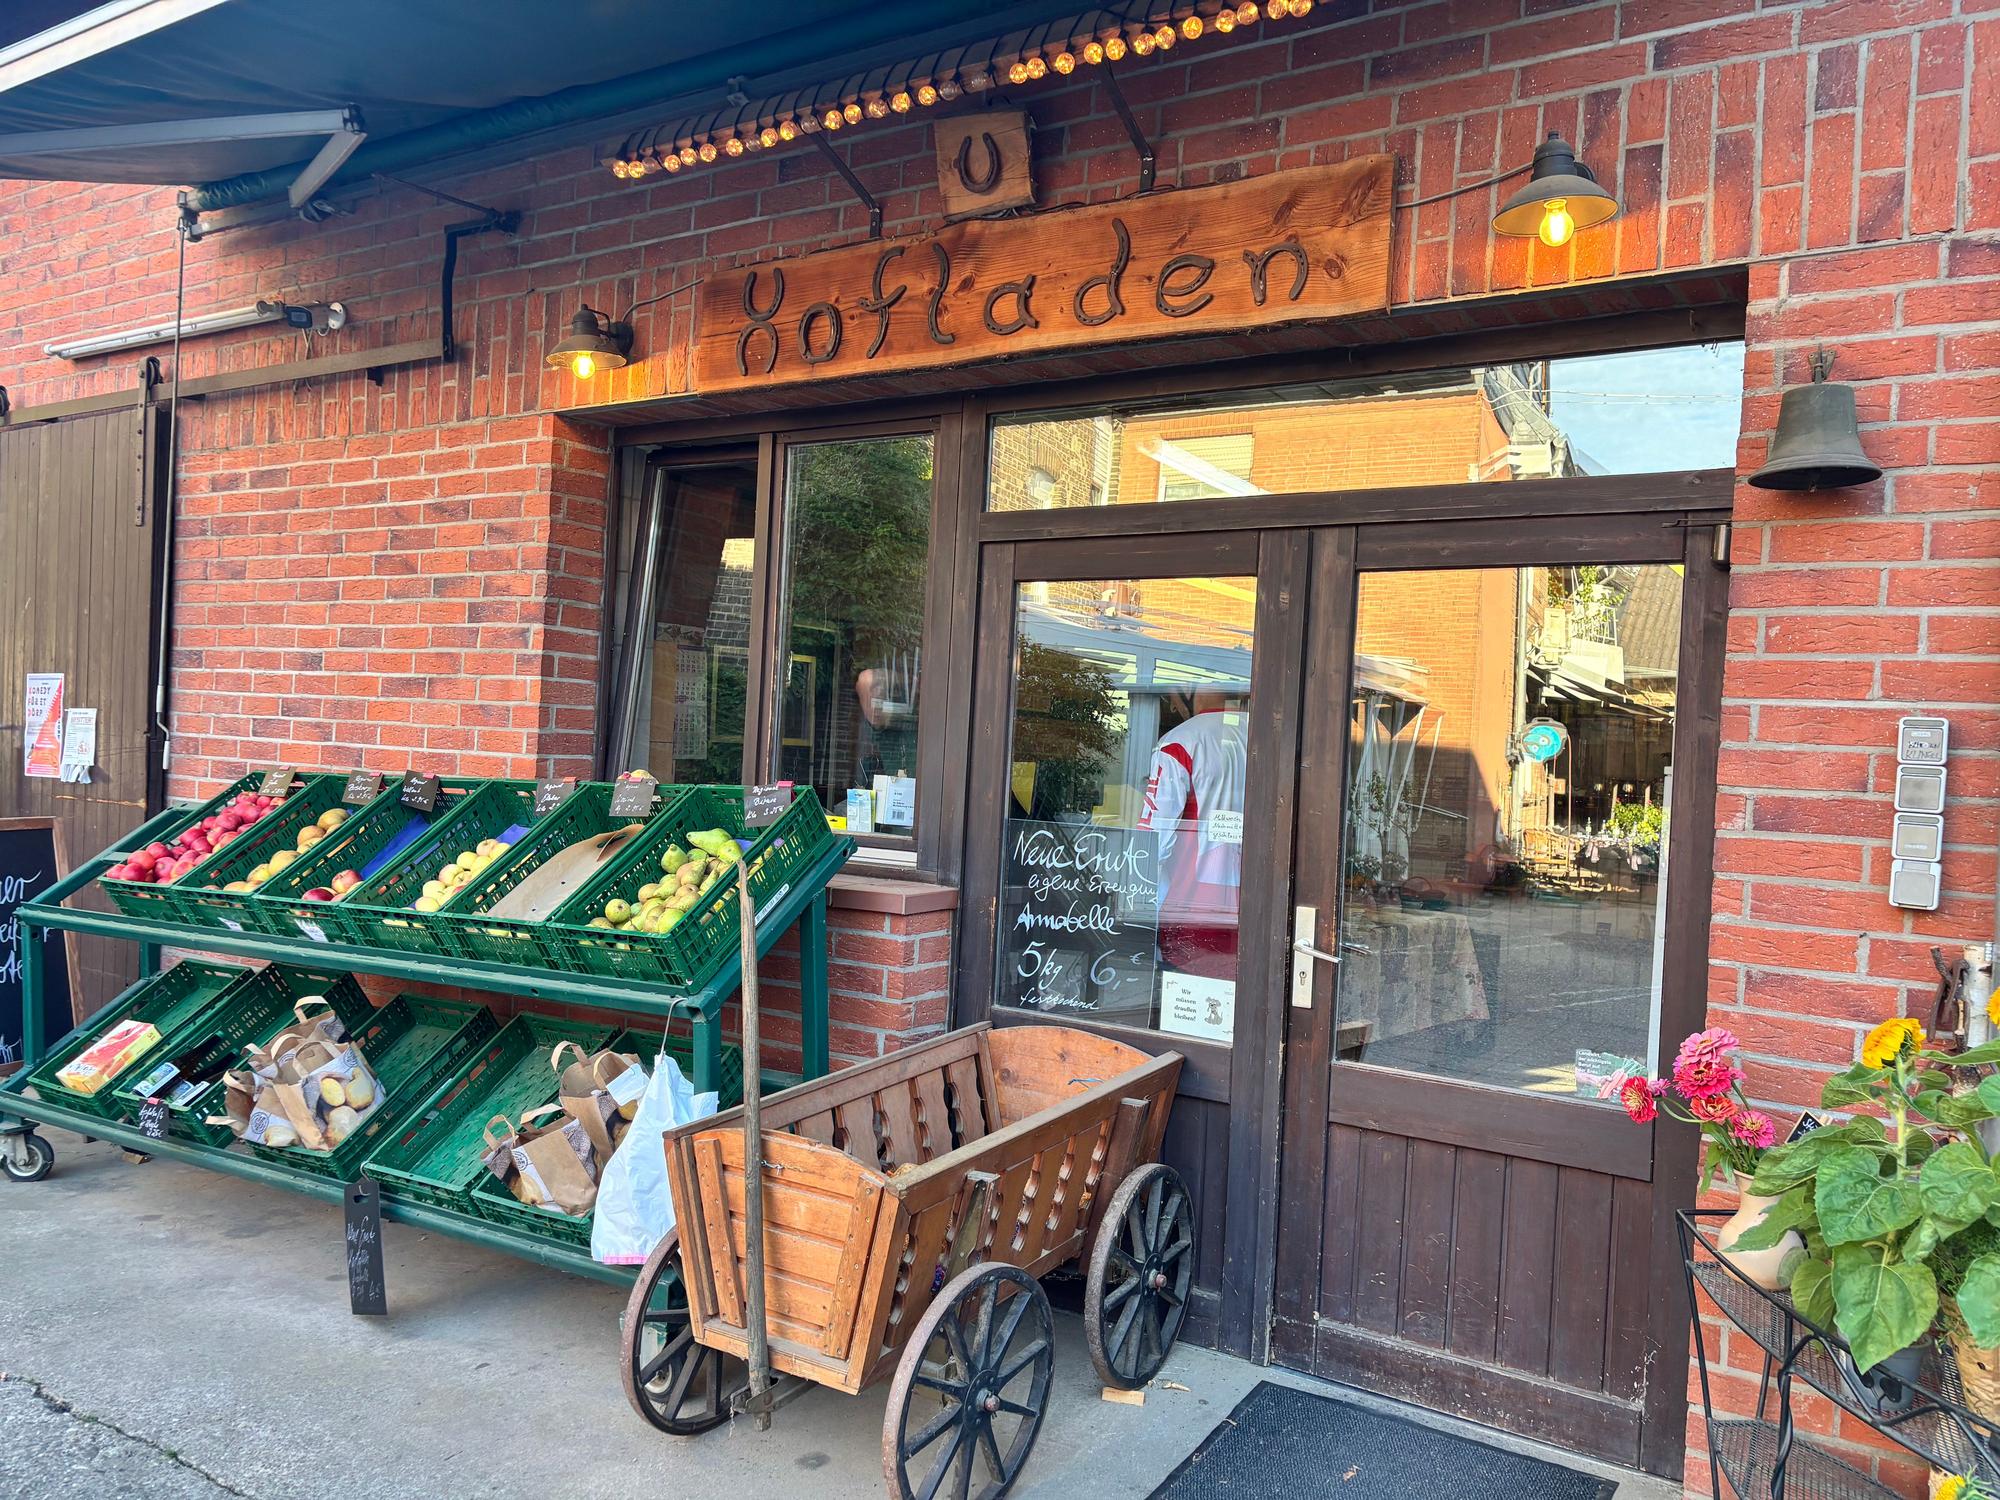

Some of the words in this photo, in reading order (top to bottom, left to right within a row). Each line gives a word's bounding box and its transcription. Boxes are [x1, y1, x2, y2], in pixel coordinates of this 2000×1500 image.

[735, 217, 1309, 377] Hofladen
[1013, 829, 1074, 868] Neue
[1074, 832, 1158, 885] Ernte
[1028, 873, 1083, 902] eigene
[1012, 900, 1122, 935] Annabelle
